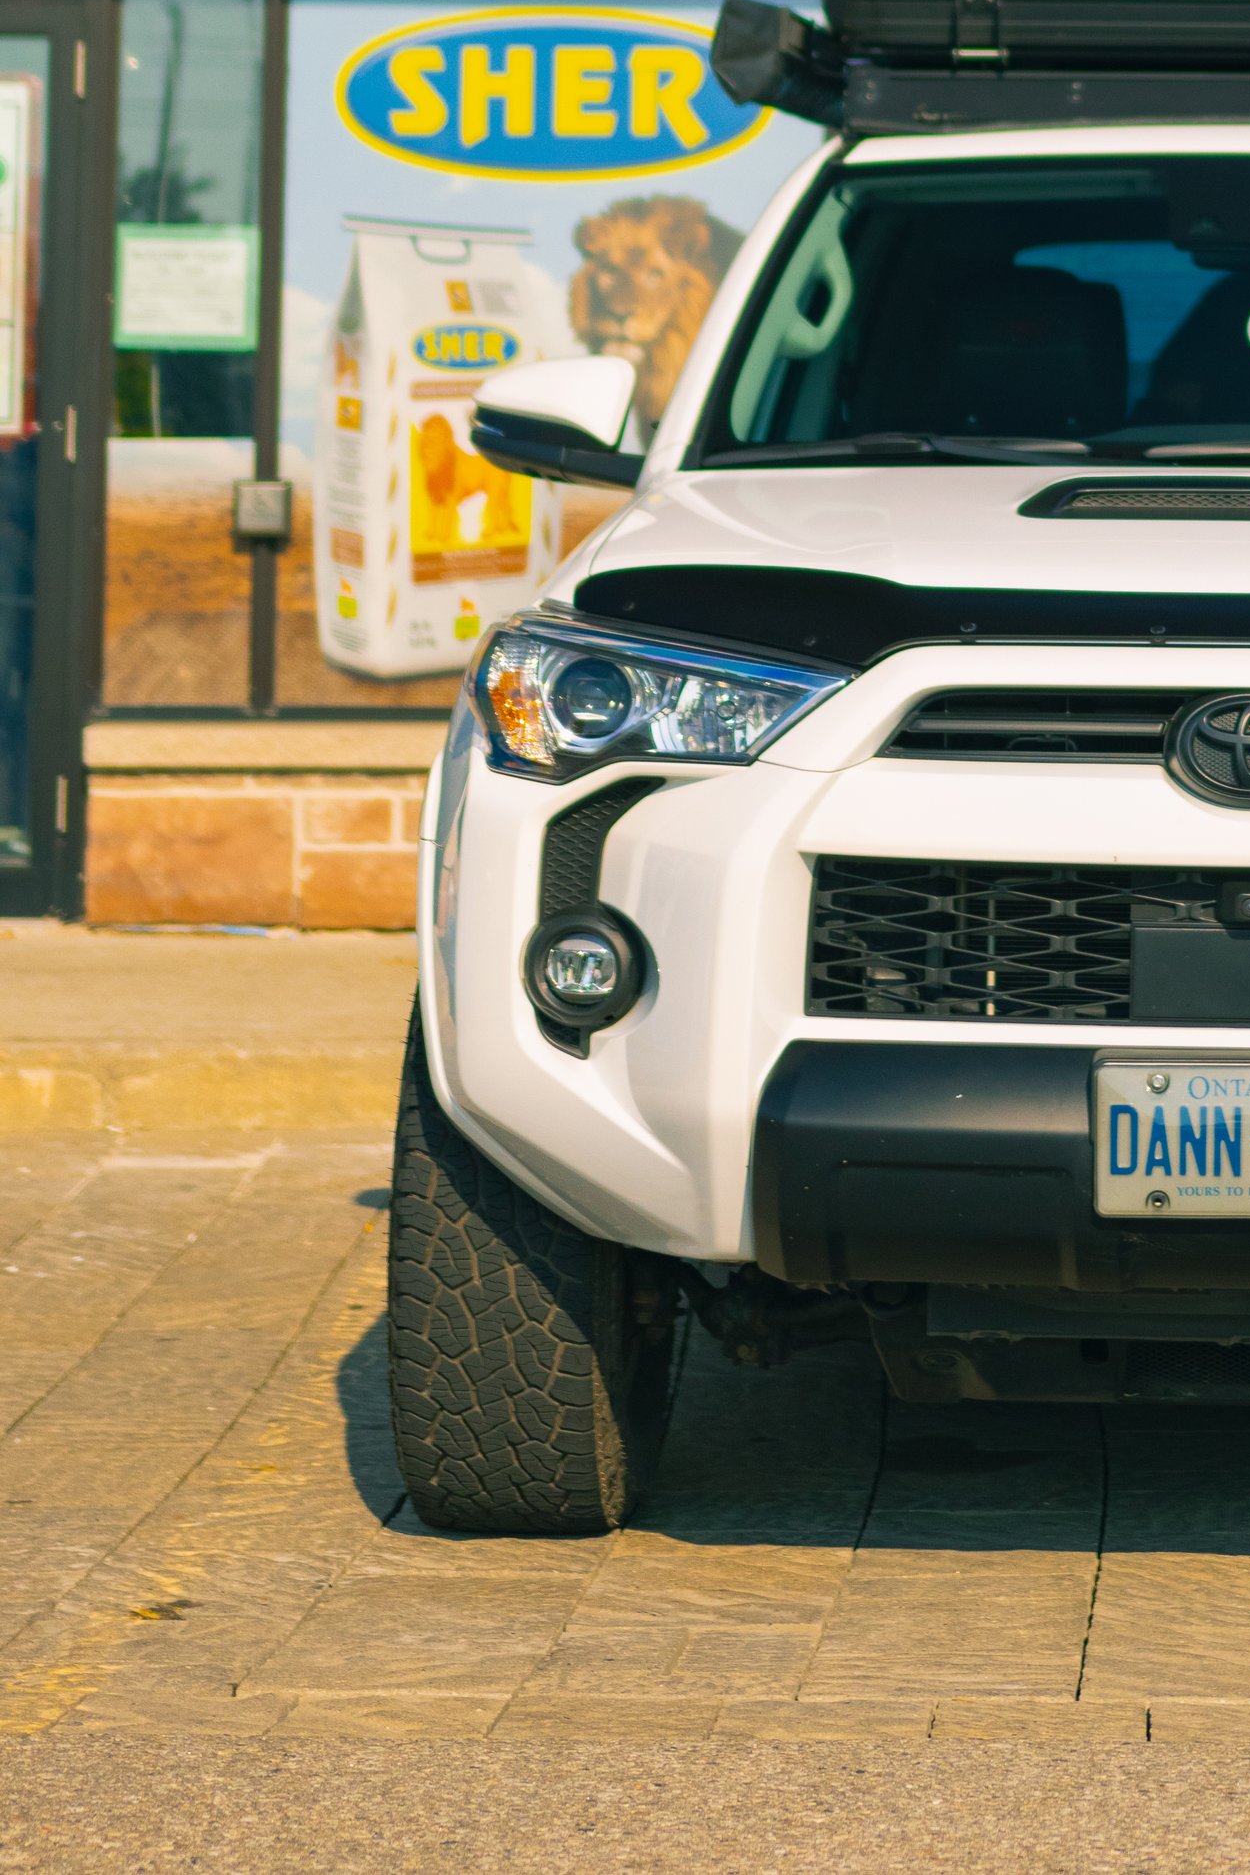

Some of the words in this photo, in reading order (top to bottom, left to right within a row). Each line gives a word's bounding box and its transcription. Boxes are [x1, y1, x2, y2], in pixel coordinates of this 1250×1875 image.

[388, 44, 711, 149] SHER
[422, 330, 507, 362] SHER
[1109, 1104, 1243, 1178] DANN
[1176, 1186, 1220, 1197] YOURS
[1227, 1186, 1244, 1197] TO
